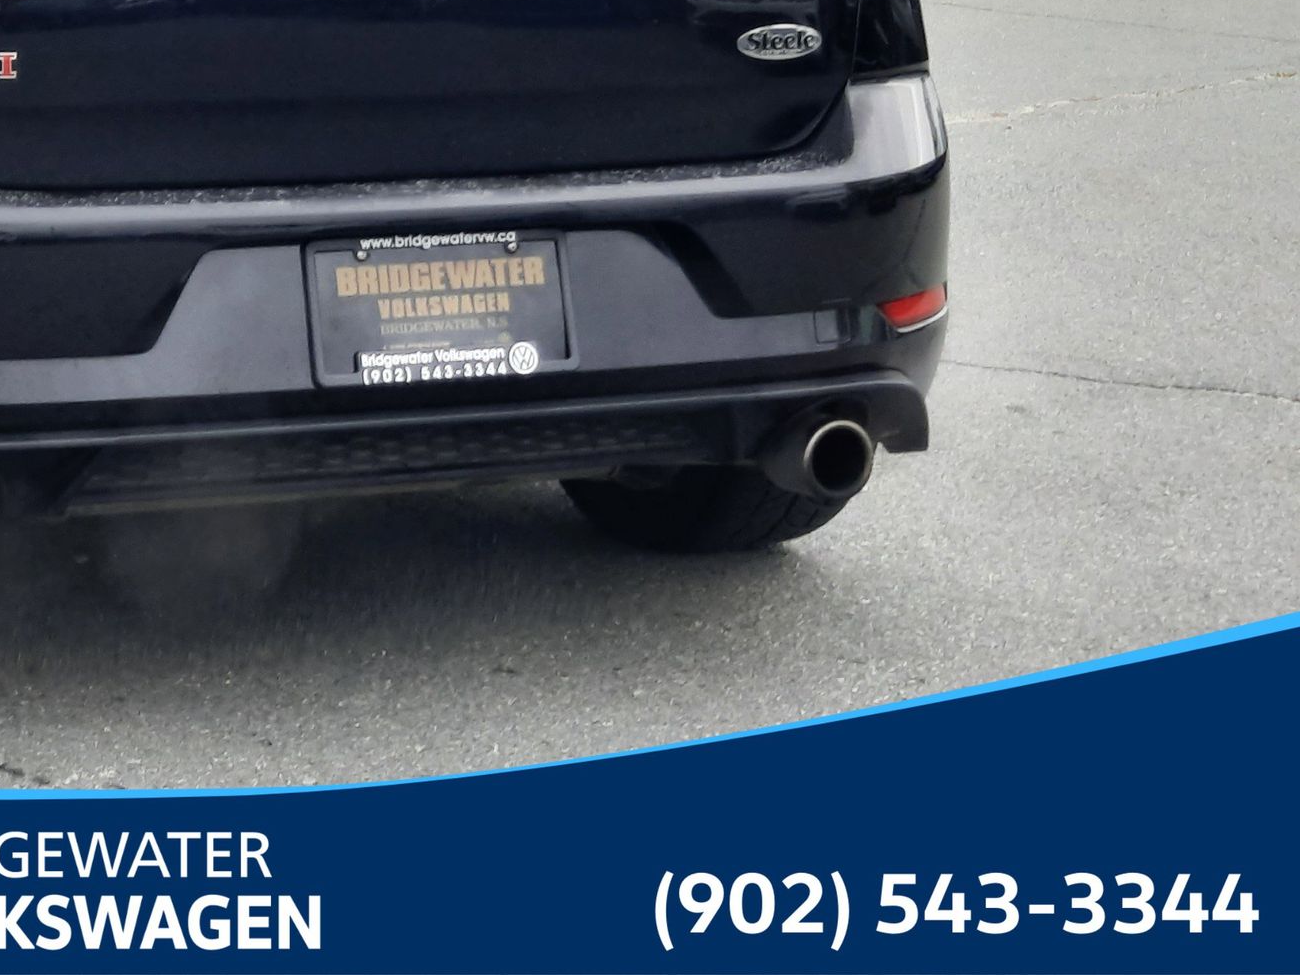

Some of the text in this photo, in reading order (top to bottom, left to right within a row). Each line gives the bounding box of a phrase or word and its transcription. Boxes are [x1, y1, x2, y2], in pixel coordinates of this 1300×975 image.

[747, 30, 815, 51] Steele
[359, 230, 517, 251] www.bridgewatervw.ca
[335, 256, 545, 298] BRIDGEWATER
[377, 292, 510, 320] VOLKSWAGEN
[360, 346, 506, 369] Bridgewater Volkswagen
[361, 361, 508, 386] (902) 543-3344
